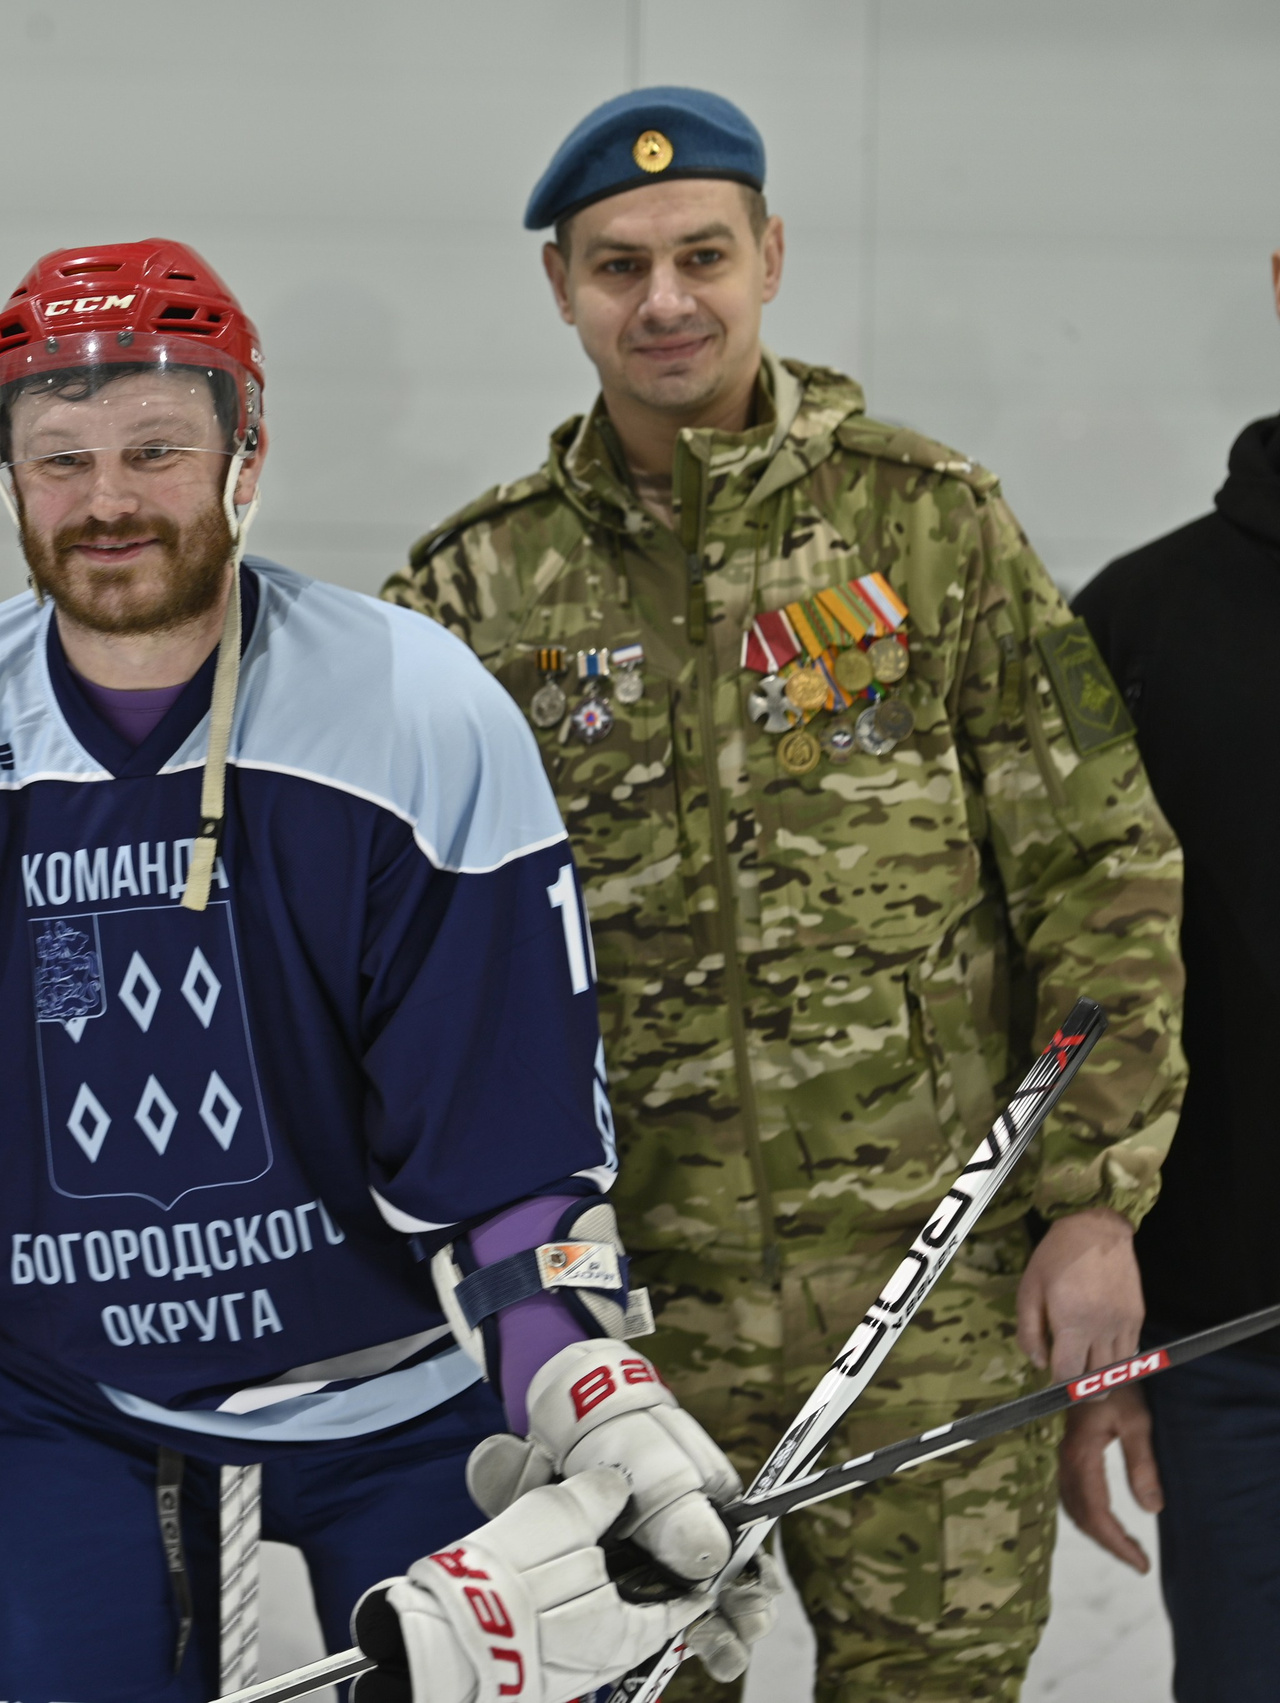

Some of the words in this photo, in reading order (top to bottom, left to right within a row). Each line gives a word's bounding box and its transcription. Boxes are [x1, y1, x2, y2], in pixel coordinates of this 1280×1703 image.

[44, 294, 137, 317] CCM
[546, 863, 598, 995] 1
[101, 1288, 284, 1347] ОКРУГА
[1075, 1352, 1161, 1397] CCM
